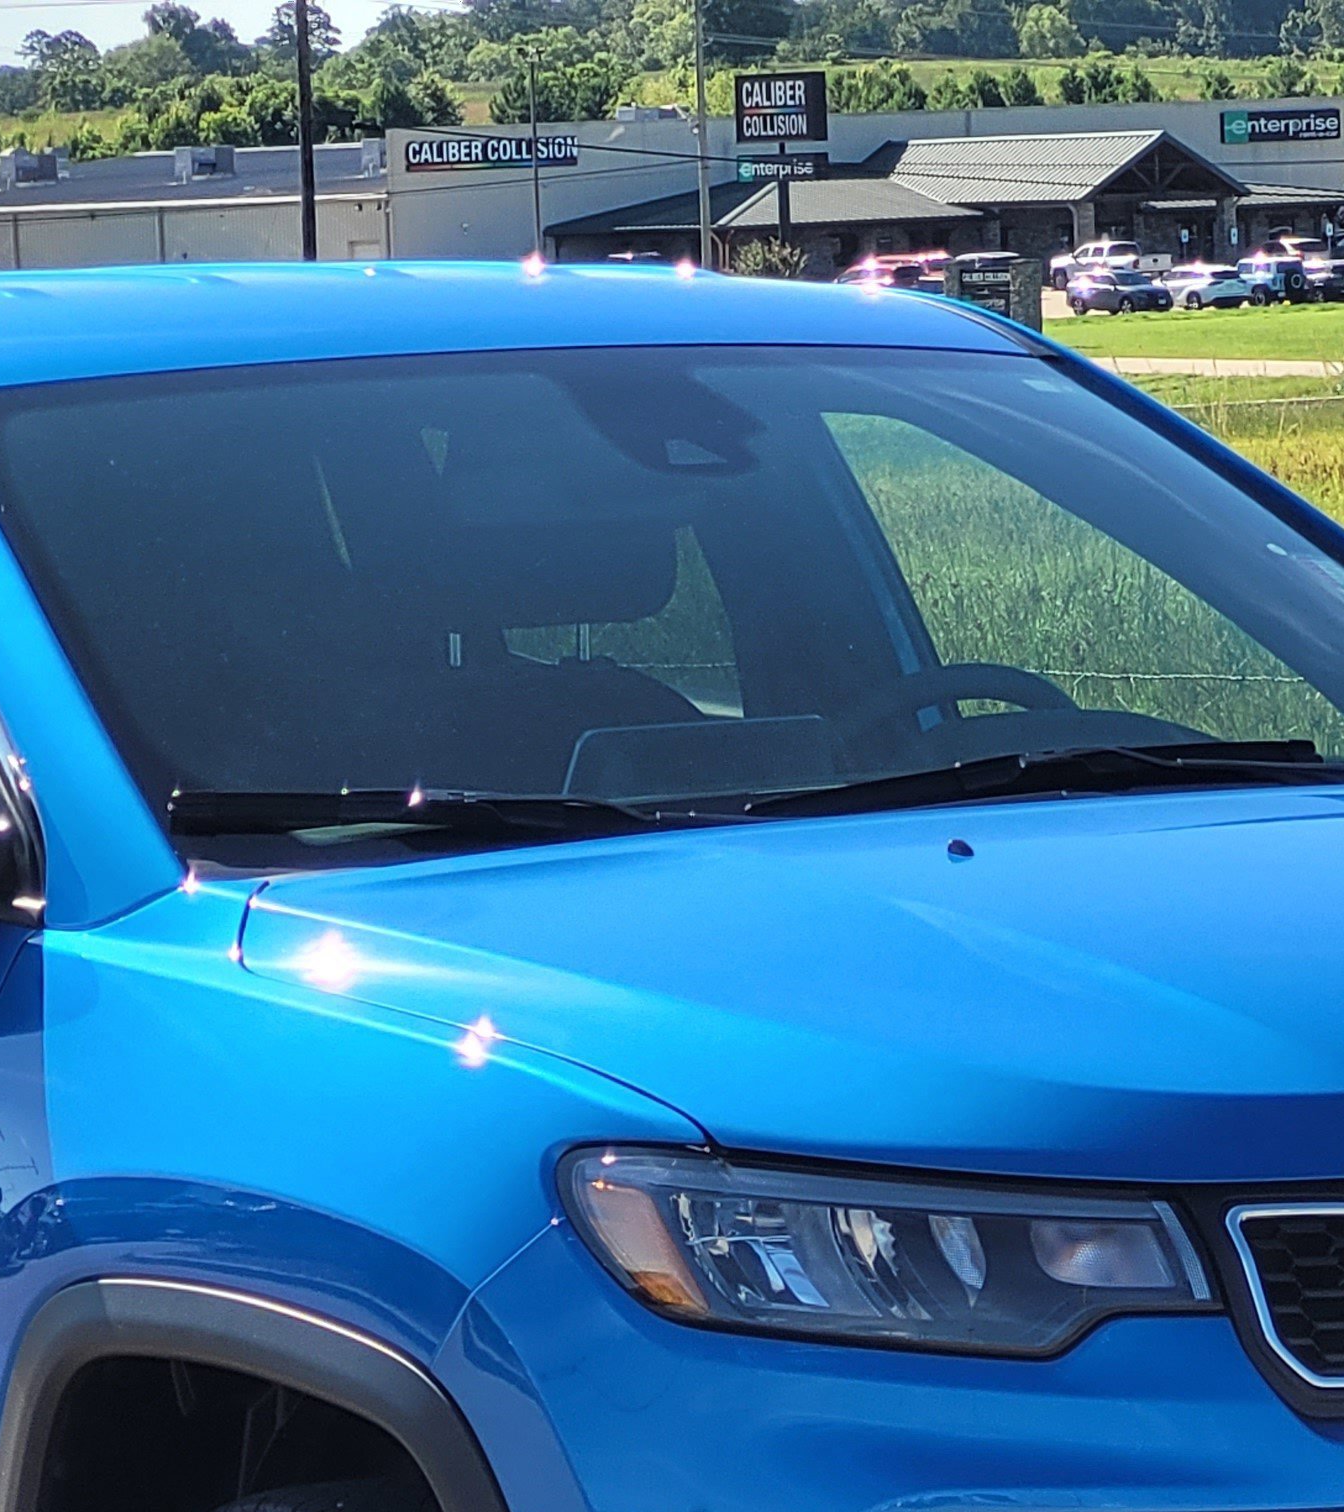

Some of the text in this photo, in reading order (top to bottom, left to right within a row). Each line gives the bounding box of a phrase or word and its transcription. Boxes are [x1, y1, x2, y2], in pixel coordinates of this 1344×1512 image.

[742, 80, 806, 107] CALIBER
[743, 114, 807, 136] COLLISION
[1224, 114, 1339, 136] enterprise
[408, 137, 579, 163] CALIBER COLLSION
[739, 159, 814, 179] enterprise
